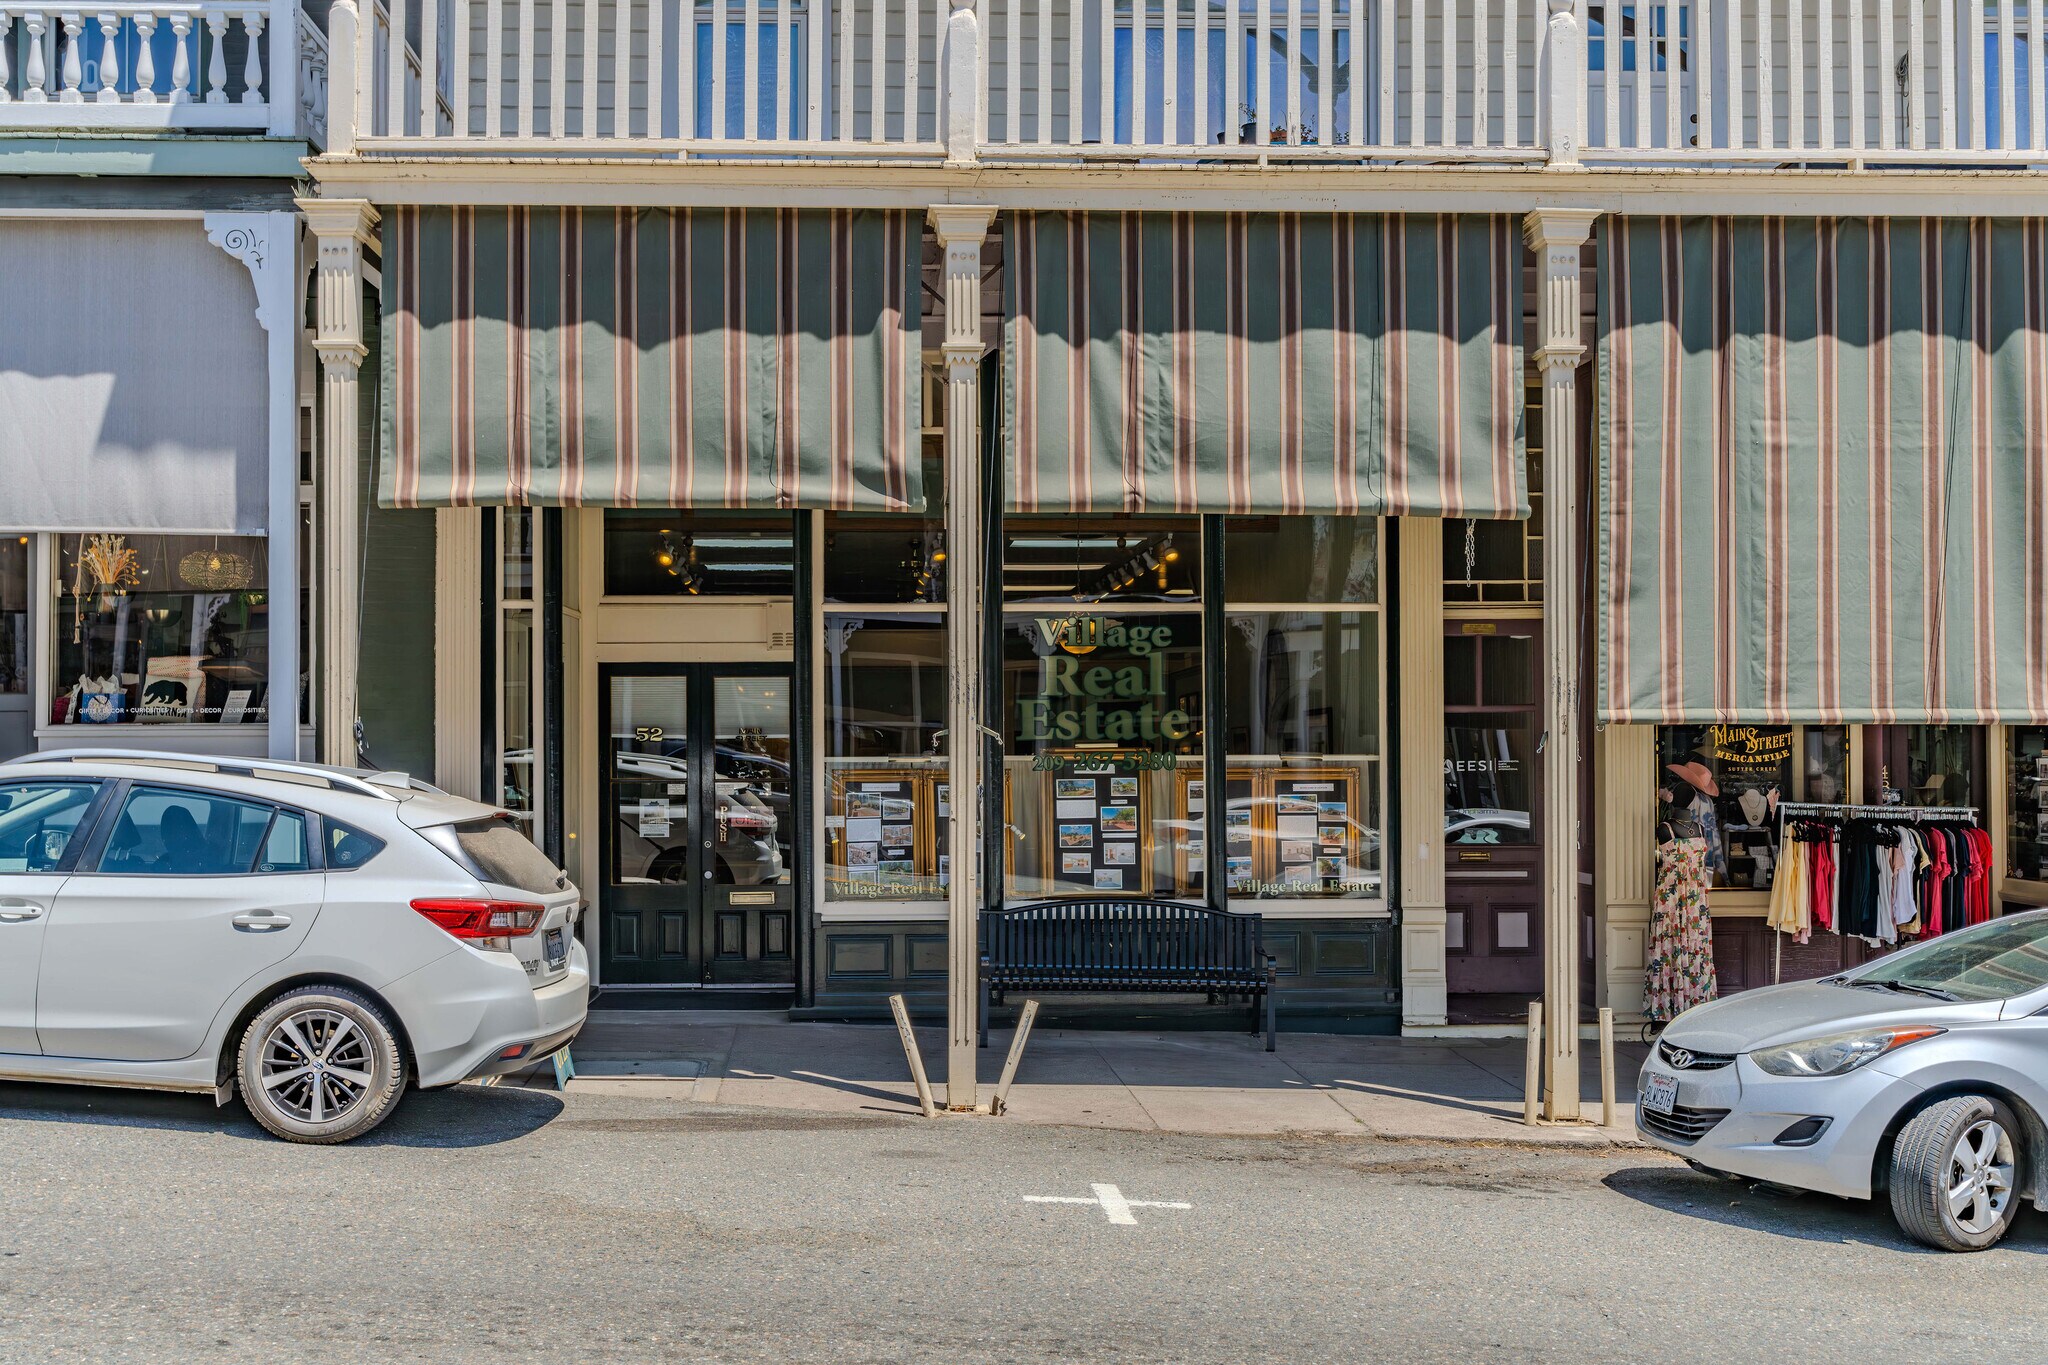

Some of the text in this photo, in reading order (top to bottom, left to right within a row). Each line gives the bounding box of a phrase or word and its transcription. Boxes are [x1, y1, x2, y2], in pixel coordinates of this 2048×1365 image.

[1035, 616, 1172, 657] Village
[1040, 651, 1167, 697] Real
[1015, 700, 1190, 741] Estate
[635, 727, 663, 742] 52
[1032, 751, 1177, 771] 209-267-5280
[1714, 749, 1790, 763] MERCANTILE
[1456, 760, 1492, 772] EESI
[719, 806, 728, 842] PUSH
[832, 881, 885, 898] Village
[891, 882, 922, 895] Real
[1234, 879, 1374, 896] Village Real Estate
